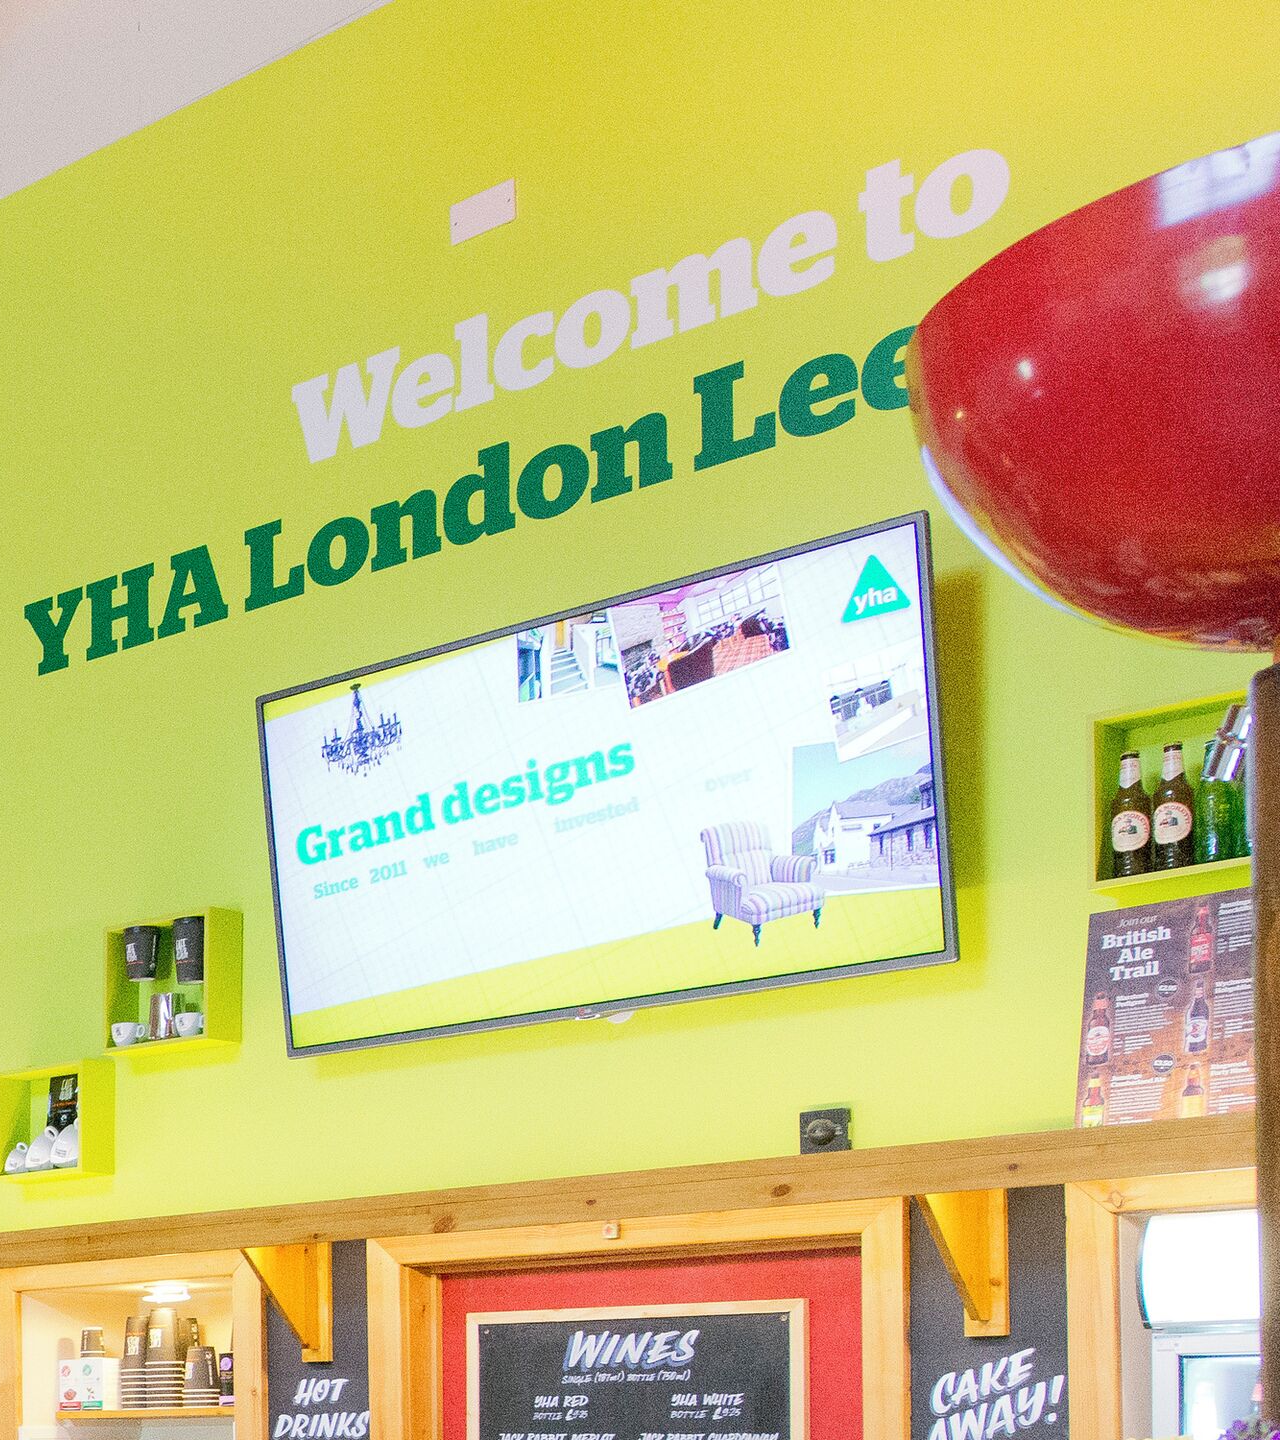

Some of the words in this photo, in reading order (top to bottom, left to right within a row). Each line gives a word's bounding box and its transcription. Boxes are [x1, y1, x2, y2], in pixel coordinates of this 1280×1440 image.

[291, 205, 838, 463] Welcome
[858, 147, 1011, 263] to
[23, 545, 228, 676] YHA
[245, 408, 673, 610] London
[693, 325, 918, 473] Lee
[853, 582, 898, 615] yha
[294, 791, 435, 867] Grand
[441, 740, 636, 821] designs
[313, 872, 359, 900] Since
[368, 860, 408, 885] 2011
[423, 849, 450, 869] we
[472, 830, 519, 855] have
[553, 797, 640, 834] invested
[704, 765, 753, 792] over
[1117, 917, 1139, 927] Join
[1140, 915, 1158, 923] our
[1101, 926, 1171, 949] British
[1117, 947, 1154, 964] Ale
[1110, 961, 1159, 981] Trail
[563, 1329, 700, 1372] WINES
[561, 1374, 592, 1385] SINGLE
[627, 1373, 655, 1382] BOTTLE
[931, 1347, 1037, 1416] CAKE
[293, 1378, 349, 1407] HOT
[534, 1396, 559, 1408] YHA
[563, 1395, 589, 1407] RED
[671, 1394, 697, 1406] YHA
[703, 1393, 744, 1406] WHITE
[274, 1411, 370, 1440] DRINKS
[533, 1412, 562, 1420] BOTTLE
[670, 1410, 708, 1419] BOTTLE
